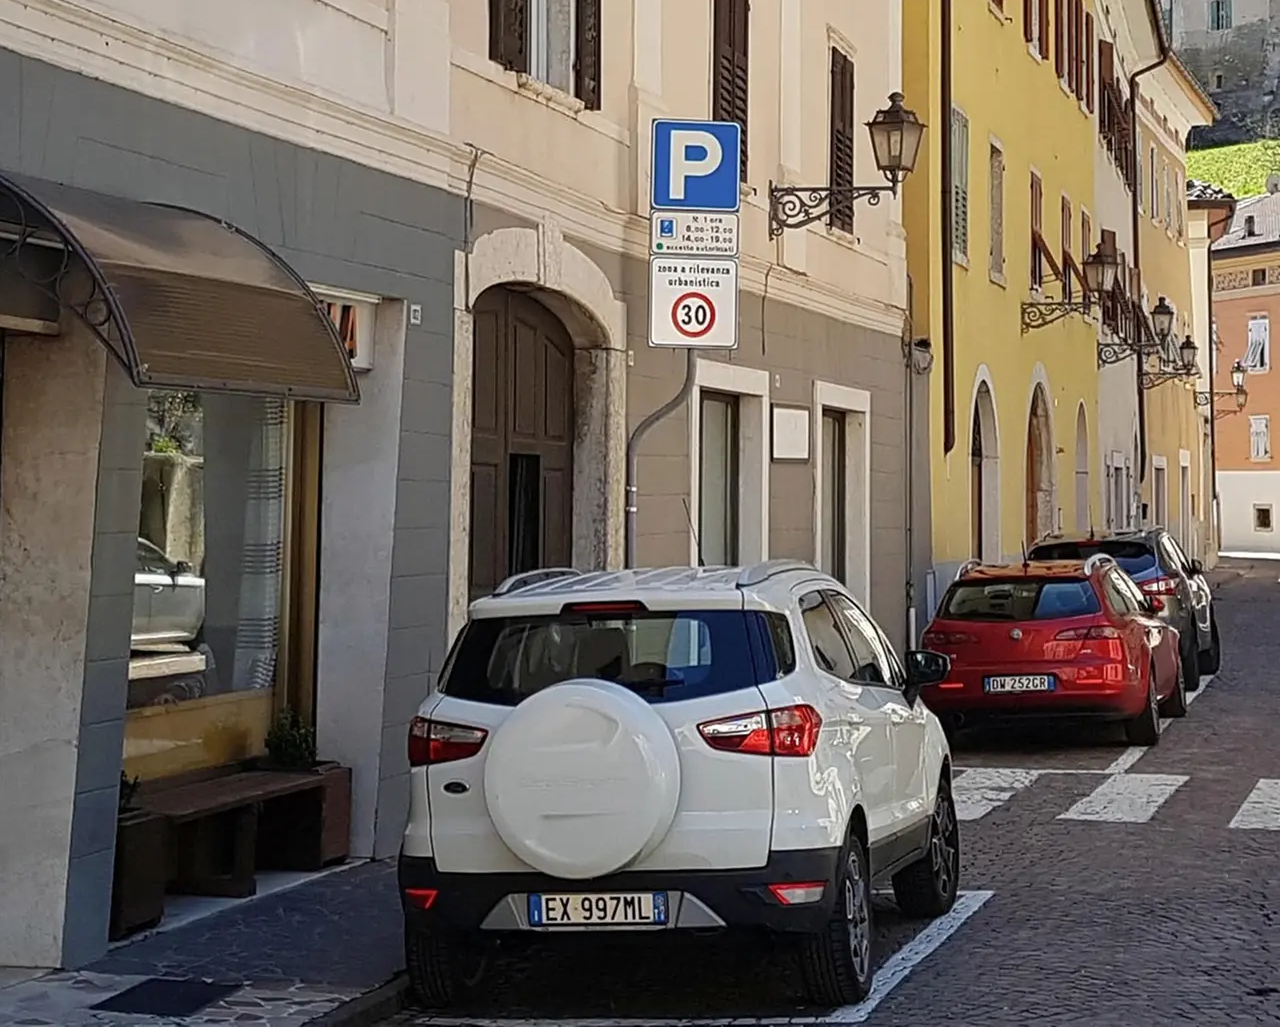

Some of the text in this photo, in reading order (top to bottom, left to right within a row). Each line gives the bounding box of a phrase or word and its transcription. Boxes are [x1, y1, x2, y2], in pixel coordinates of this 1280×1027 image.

[669, 129, 723, 200] P
[658, 265, 678, 273] zona
[689, 264, 730, 275] rilevanza
[668, 276, 720, 288] urbanistica
[681, 304, 707, 326] 30
[545, 897, 571, 921] EX
[581, 896, 650, 921] 997ML
